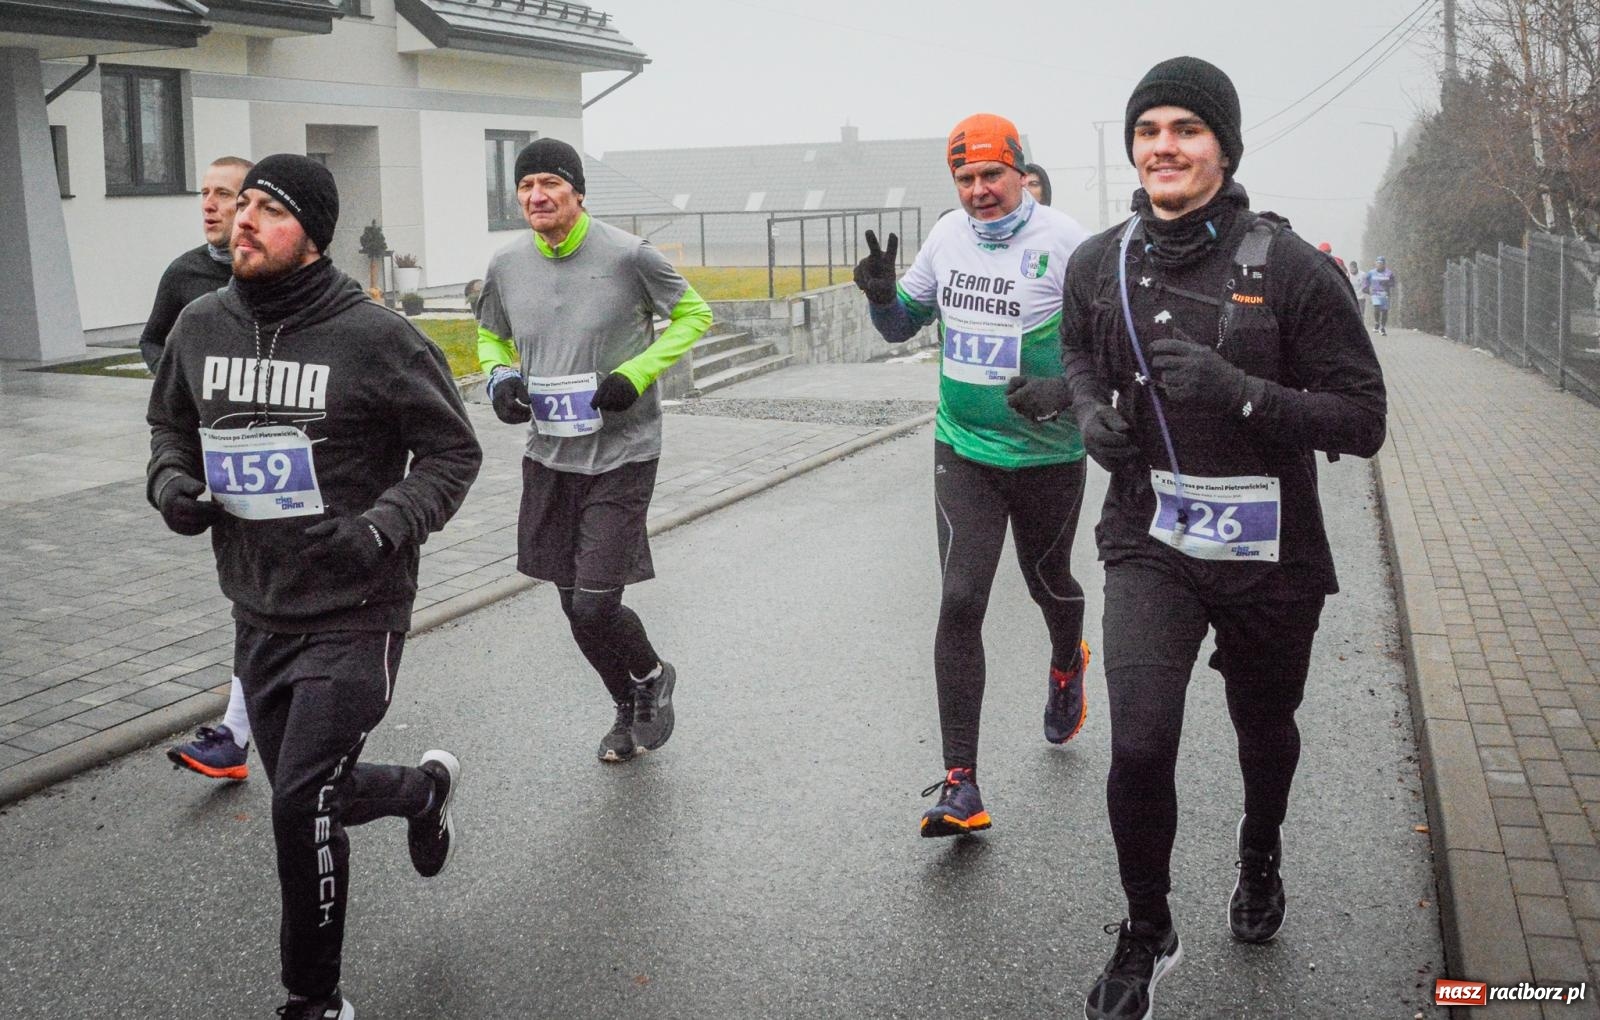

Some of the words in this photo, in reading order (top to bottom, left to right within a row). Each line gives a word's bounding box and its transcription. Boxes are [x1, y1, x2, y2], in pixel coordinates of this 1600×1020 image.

[949, 269, 992, 293] TEAM
[992, 276, 1016, 295] OF
[942, 286, 1021, 317] RUNNERS
[952, 333, 1005, 365] 117
[202, 356, 330, 410] PUMA
[544, 395, 577, 420] 21
[221, 453, 292, 492] 159
[1189, 502, 1242, 541] 26
